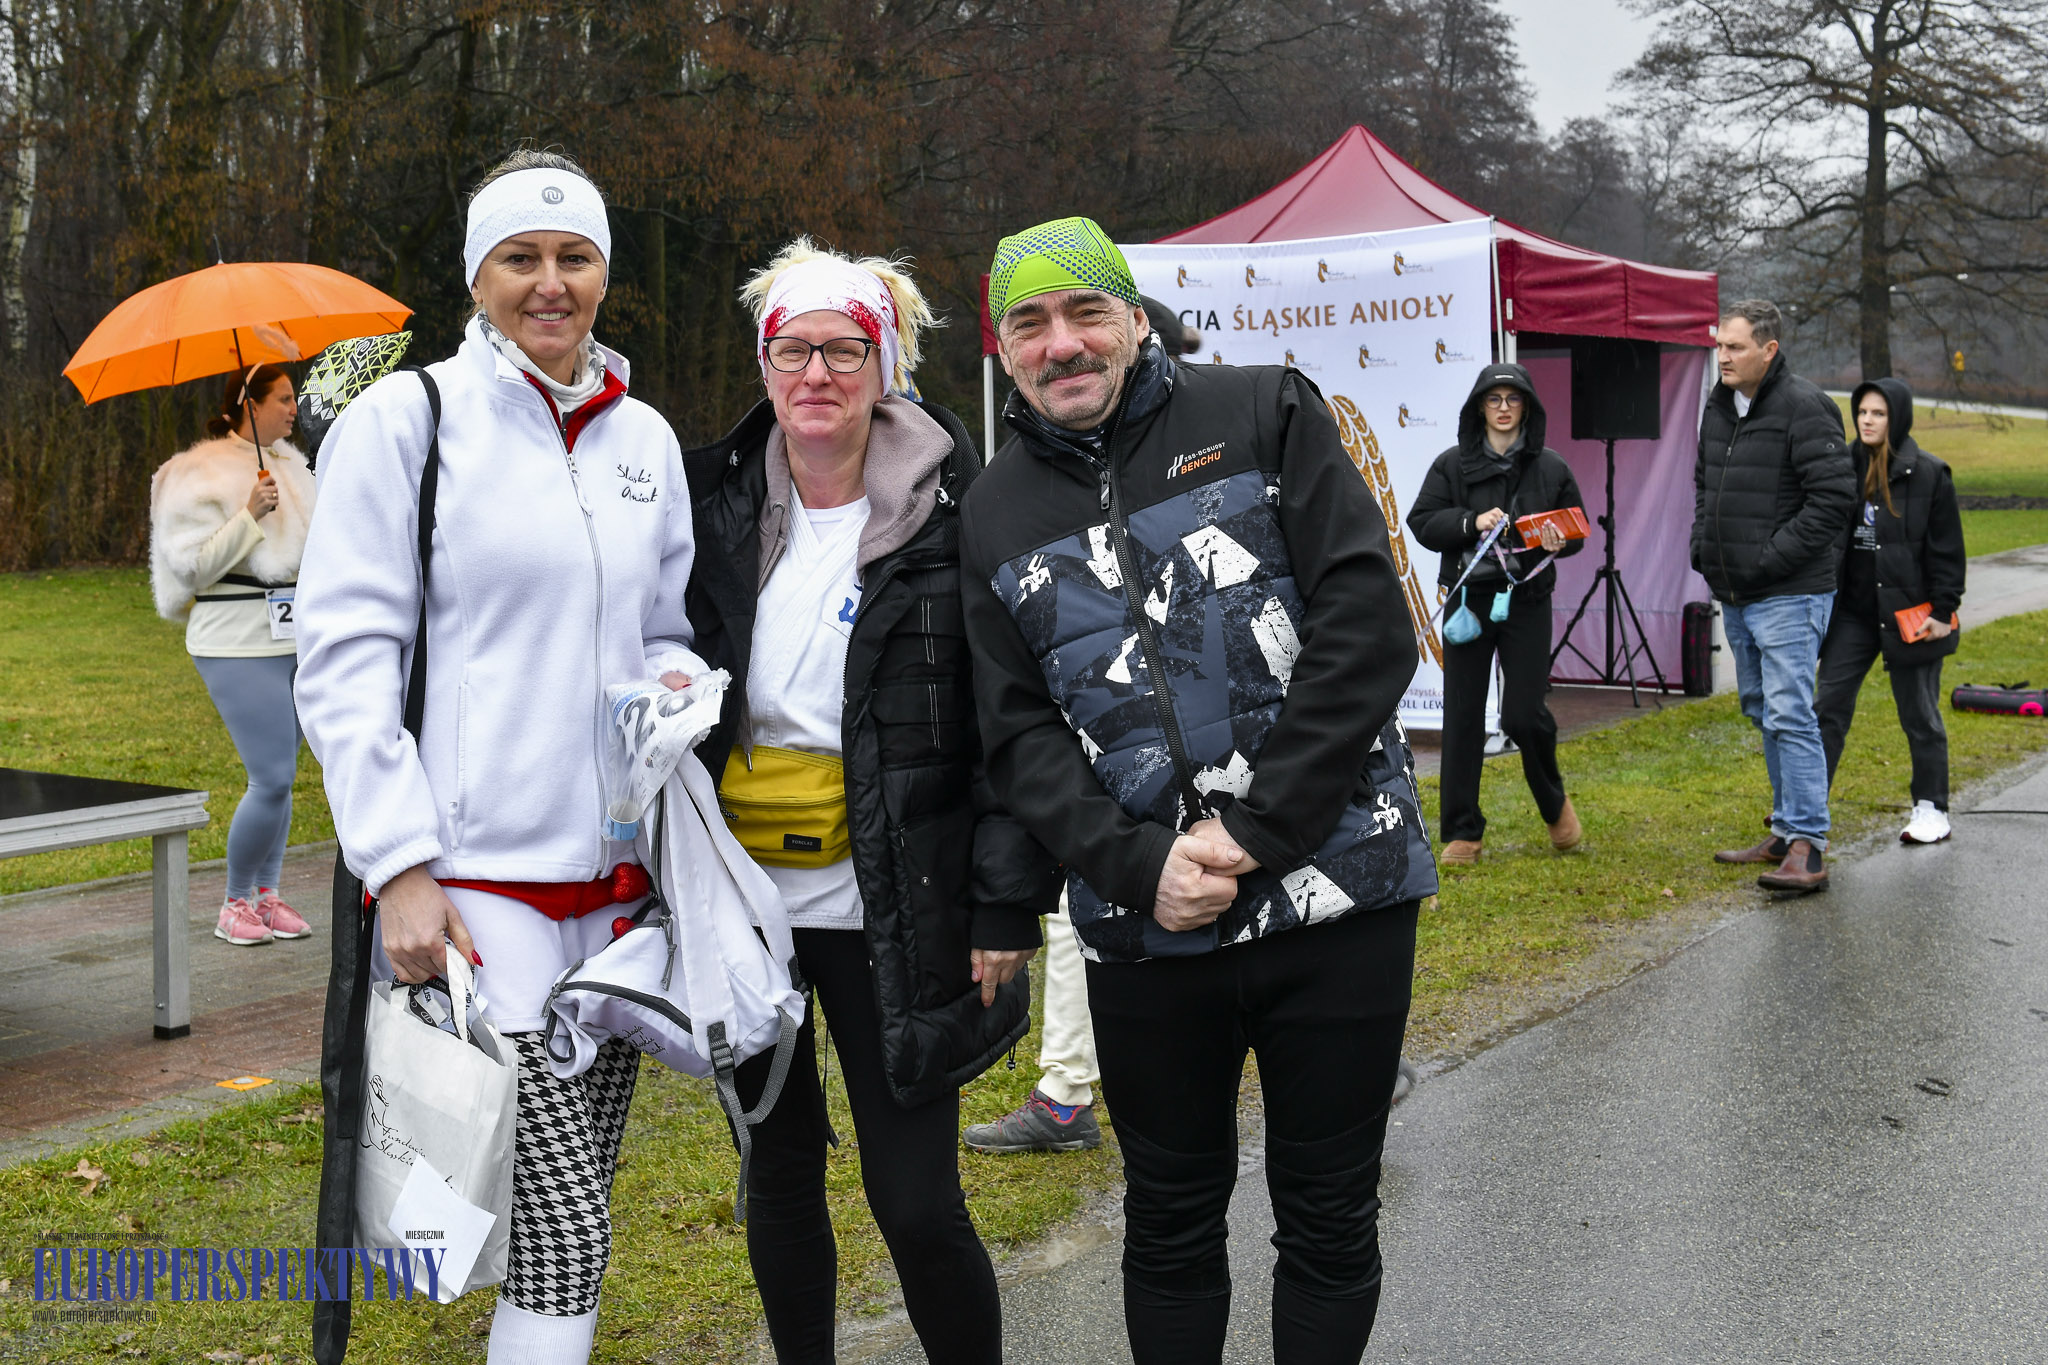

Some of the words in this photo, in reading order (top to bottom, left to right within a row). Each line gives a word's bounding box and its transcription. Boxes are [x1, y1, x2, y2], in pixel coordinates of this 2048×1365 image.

[1232, 304, 1337, 337] ŚLĄSKIE
[1350, 293, 1454, 325] ANIOŁY
[1181, 450, 1221, 475] BENCHU
